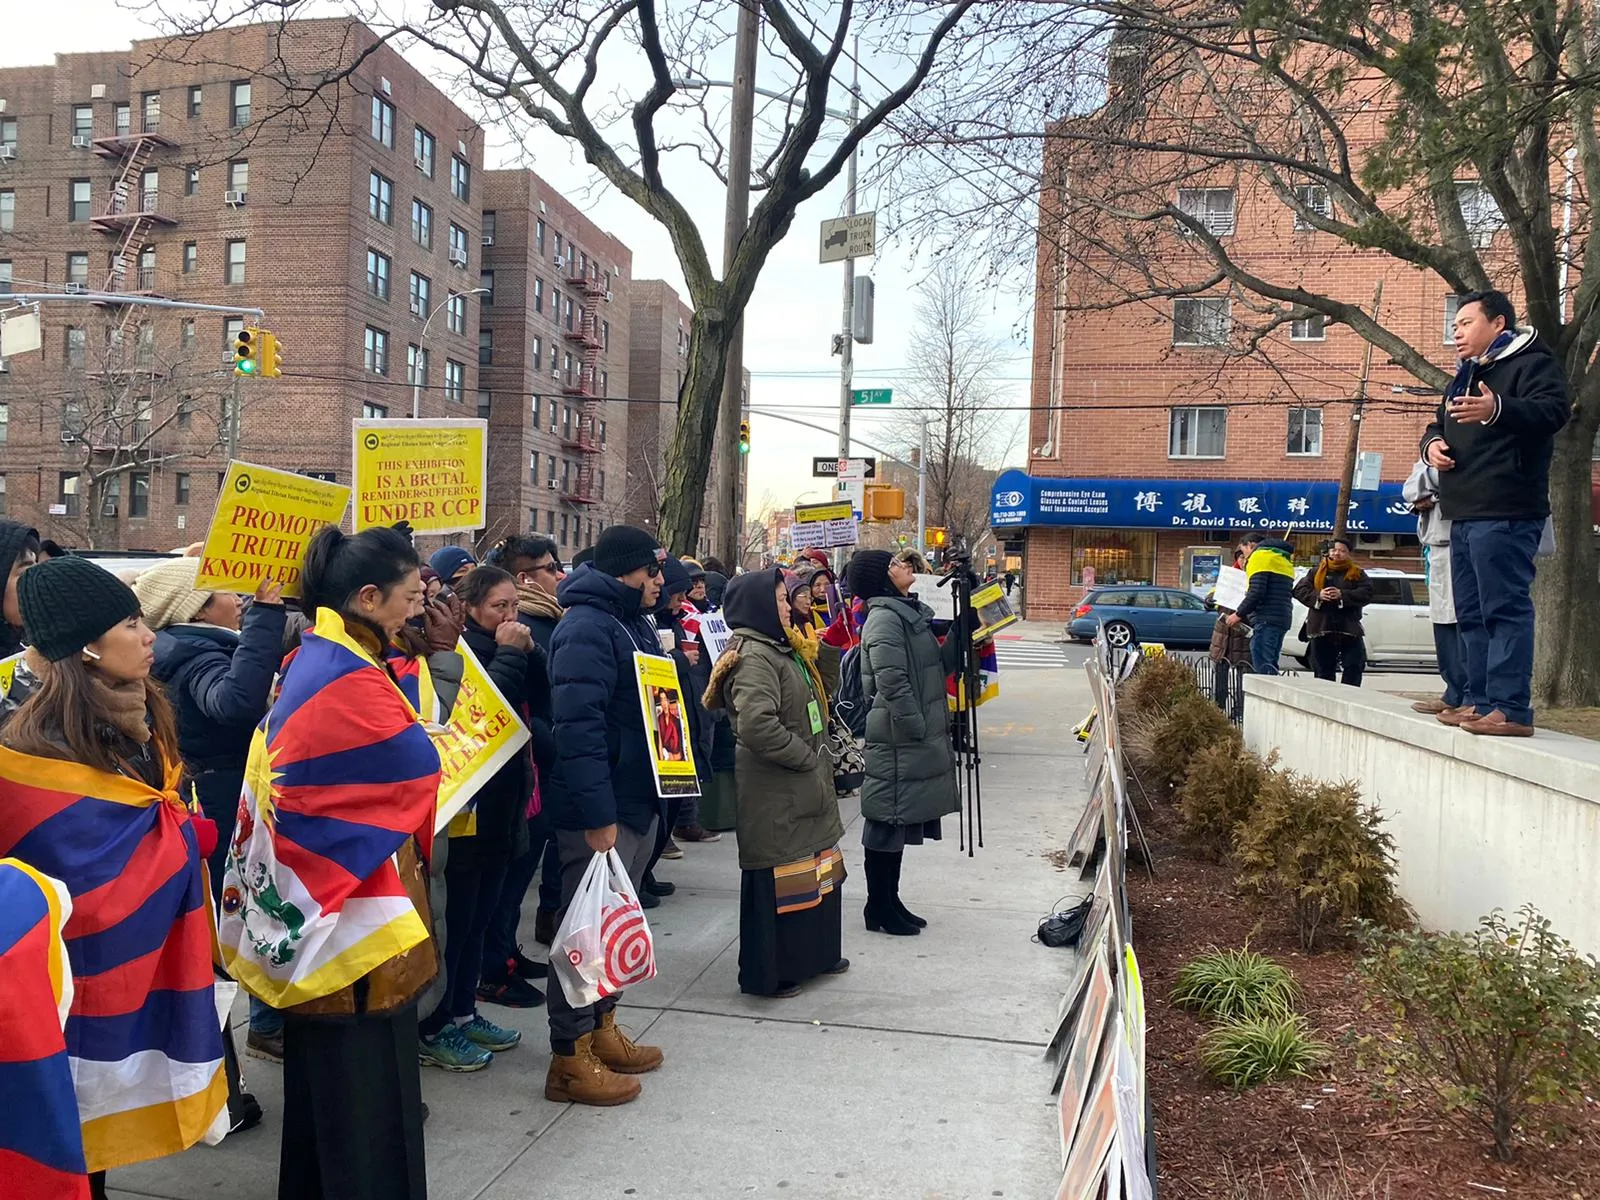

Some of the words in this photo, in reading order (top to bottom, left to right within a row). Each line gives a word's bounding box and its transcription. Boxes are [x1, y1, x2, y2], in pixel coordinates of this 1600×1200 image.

[850, 230, 872, 242] TRUCK
[849, 242, 873, 254] ROUTE
[861, 390, 874, 403] 51
[377, 460, 402, 471] THIS
[405, 458, 466, 470] EXHIBITION
[821, 463, 838, 472] ONE
[377, 475, 391, 489] IS
[395, 475, 406, 488] A
[410, 472, 469, 488] BRUTAL
[362, 489, 420, 501] REMINDER
[421, 486, 478, 498] SUFFERING
[1040, 489, 1079, 498] Comprehensive
[1081, 490, 1091, 498] Eye
[1092, 490, 1106, 498] Exam
[1040, 497, 1061, 505] Glasses
[1089, 498, 1108, 506] Lenses
[364, 501, 436, 523] UNDER
[442, 498, 480, 517] CCP
[1084, 505, 1109, 514] Accepted
[1172, 515, 1188, 525] Dr.
[1192, 516, 1225, 526] David
[1228, 517, 1255, 529] Tsai,
[1259, 518, 1335, 531] Optometrist,
[1346, 520, 1369, 529] LLC.
[230, 532, 301, 561] TRUTH
[200, 556, 301, 585] KNOWLED
[706, 619, 727, 634] LONG
[715, 638, 728, 653] LIV
[468, 703, 488, 725] &
